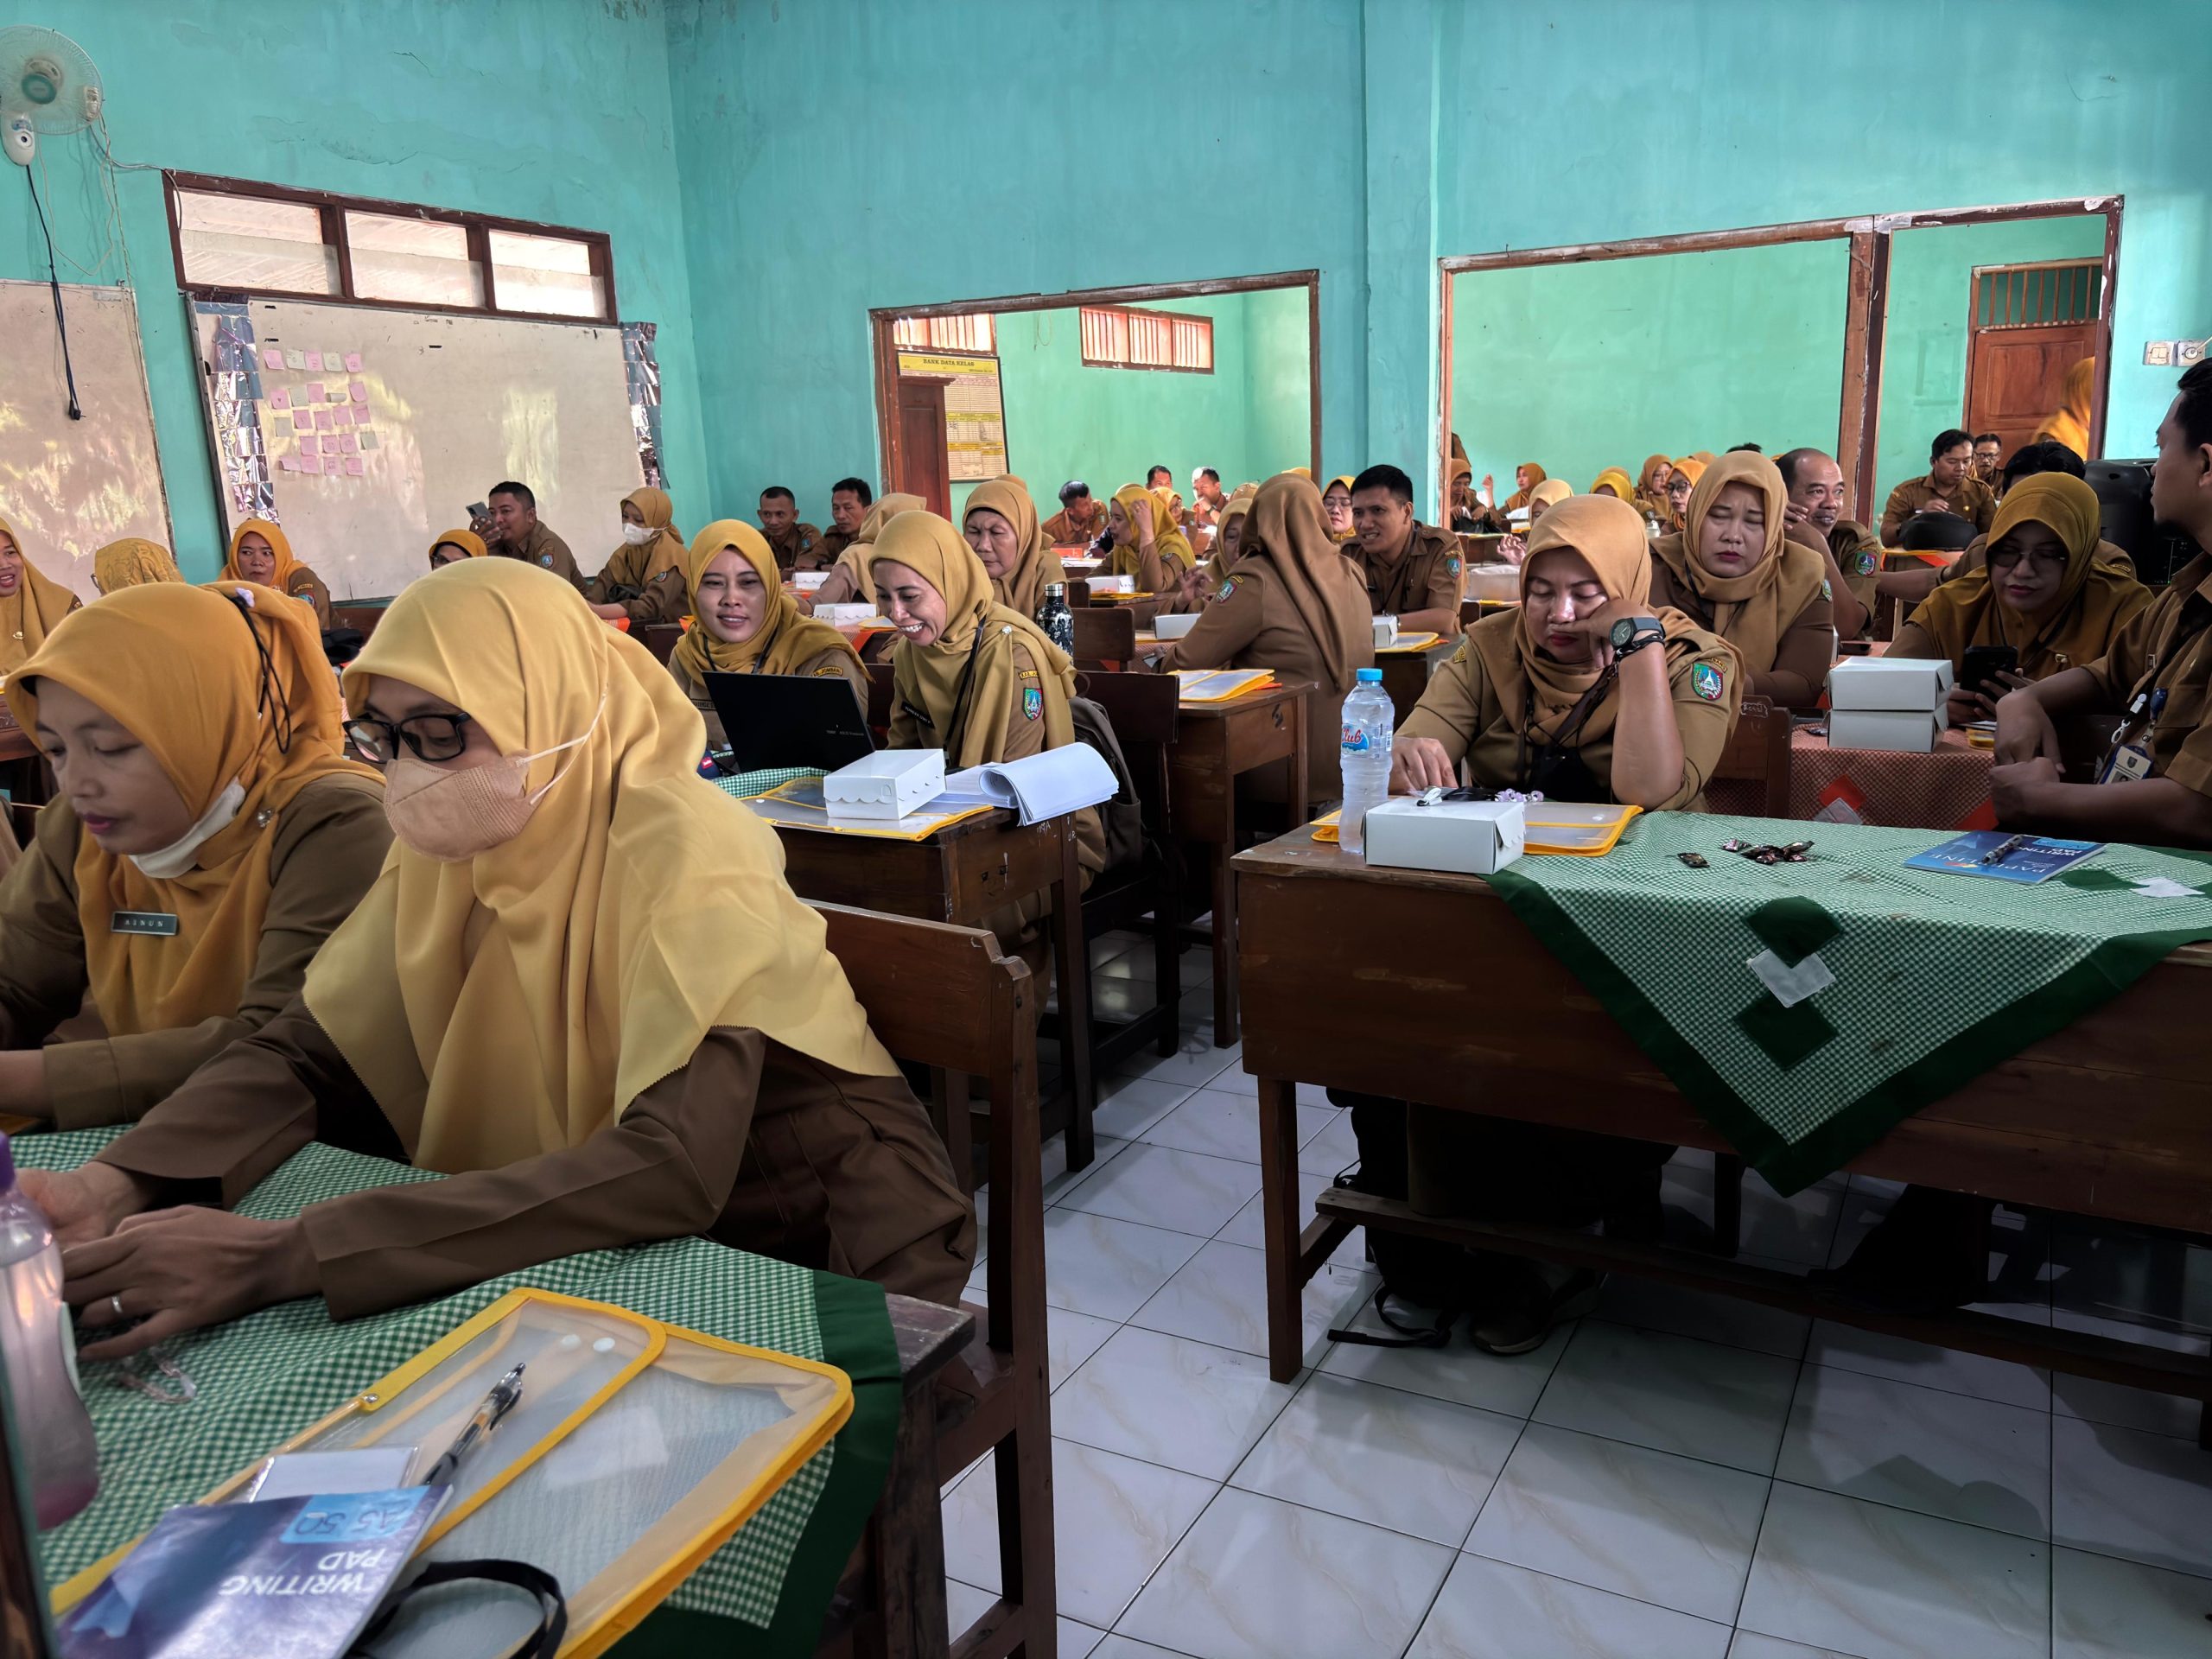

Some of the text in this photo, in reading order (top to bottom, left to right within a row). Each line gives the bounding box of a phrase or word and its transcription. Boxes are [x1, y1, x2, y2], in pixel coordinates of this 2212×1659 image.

[124, 918, 164, 927] AINUN
[295, 1512, 346, 1535] 50
[317, 1548, 387, 1571] PAD
[218, 1572, 365, 1596] WRITING
